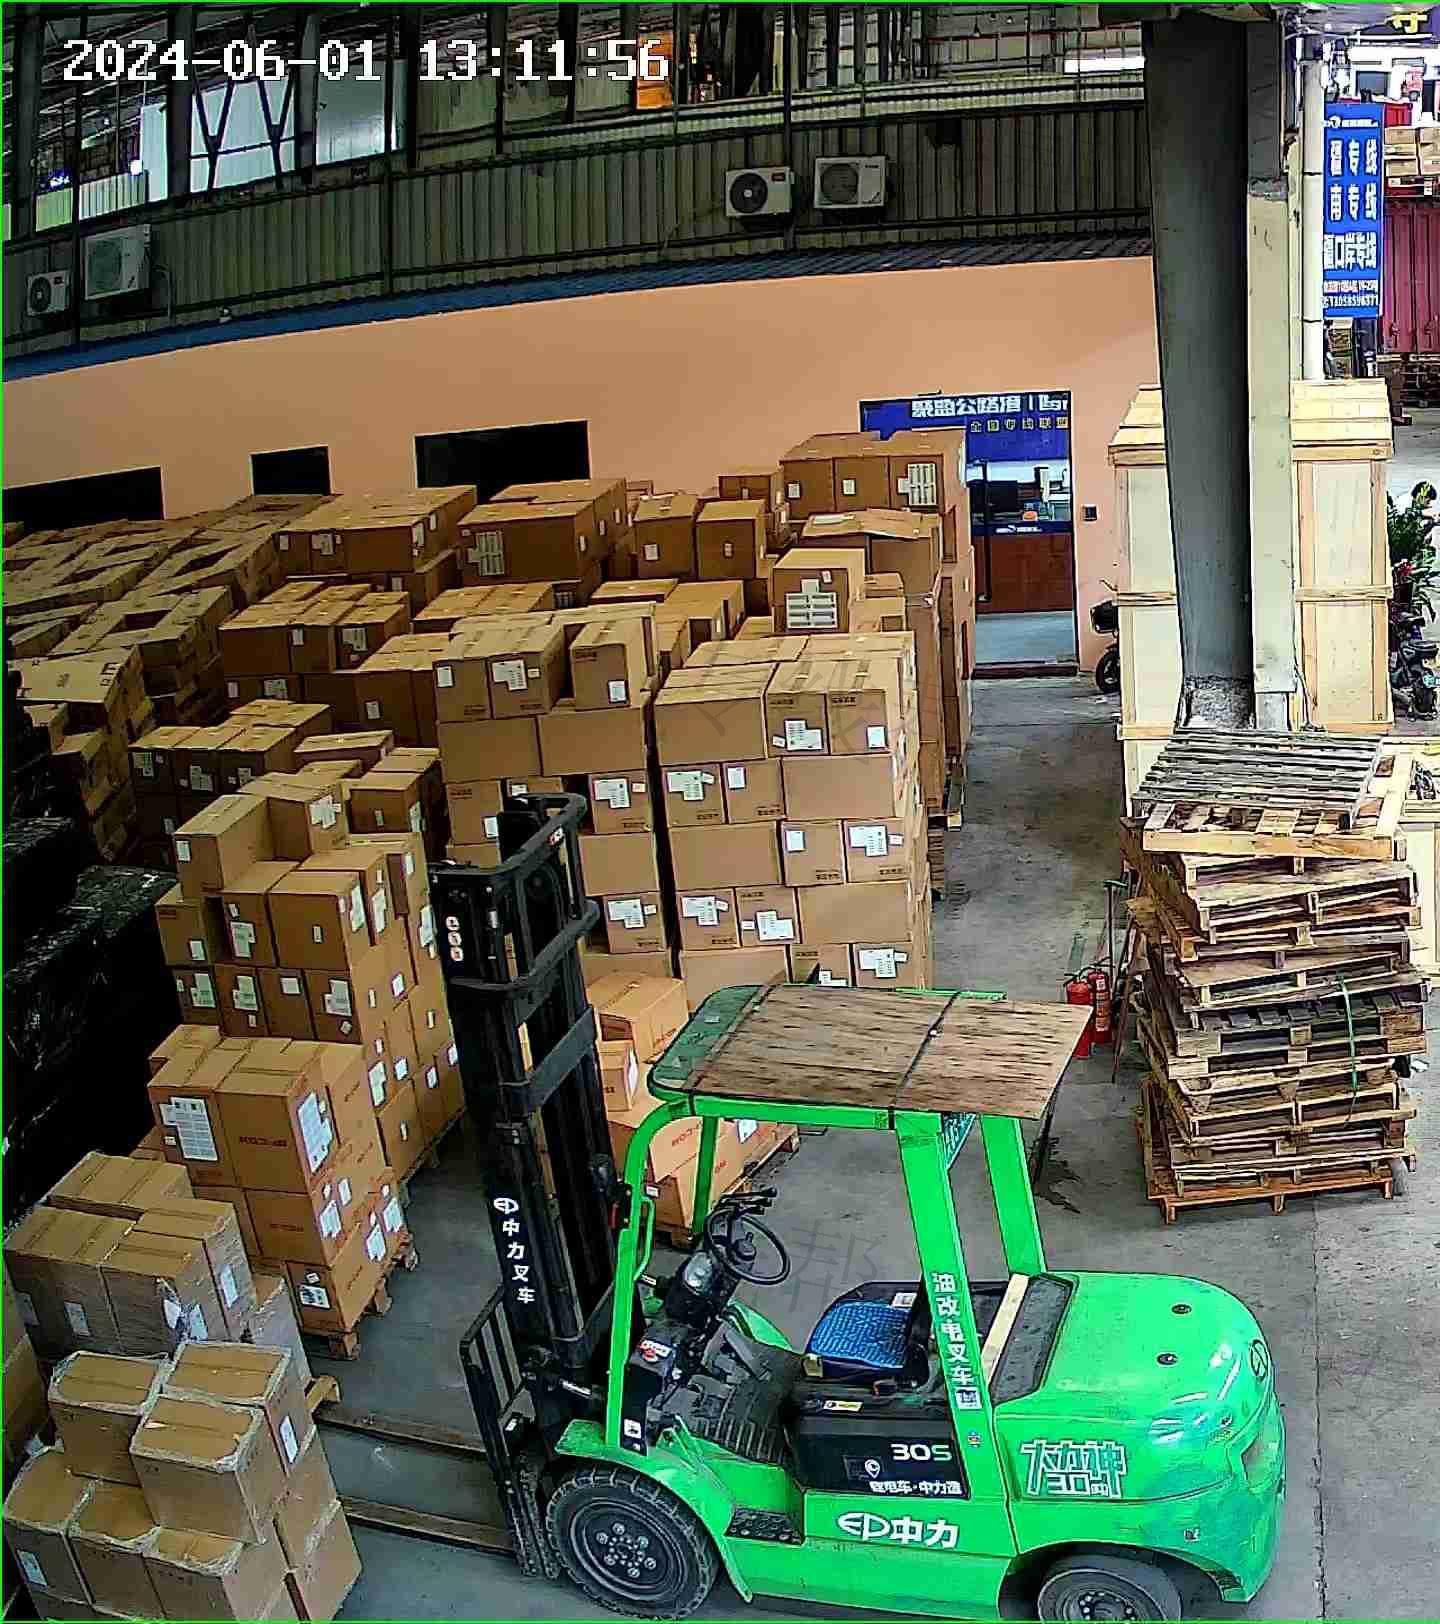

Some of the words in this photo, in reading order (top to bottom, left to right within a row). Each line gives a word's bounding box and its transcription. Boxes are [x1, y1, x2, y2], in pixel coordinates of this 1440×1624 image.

[501, 1217, 536, 1305] 中力叉车
[930, 1271, 975, 1386] 油改电叉车
[890, 1442, 953, 1462] 30S
